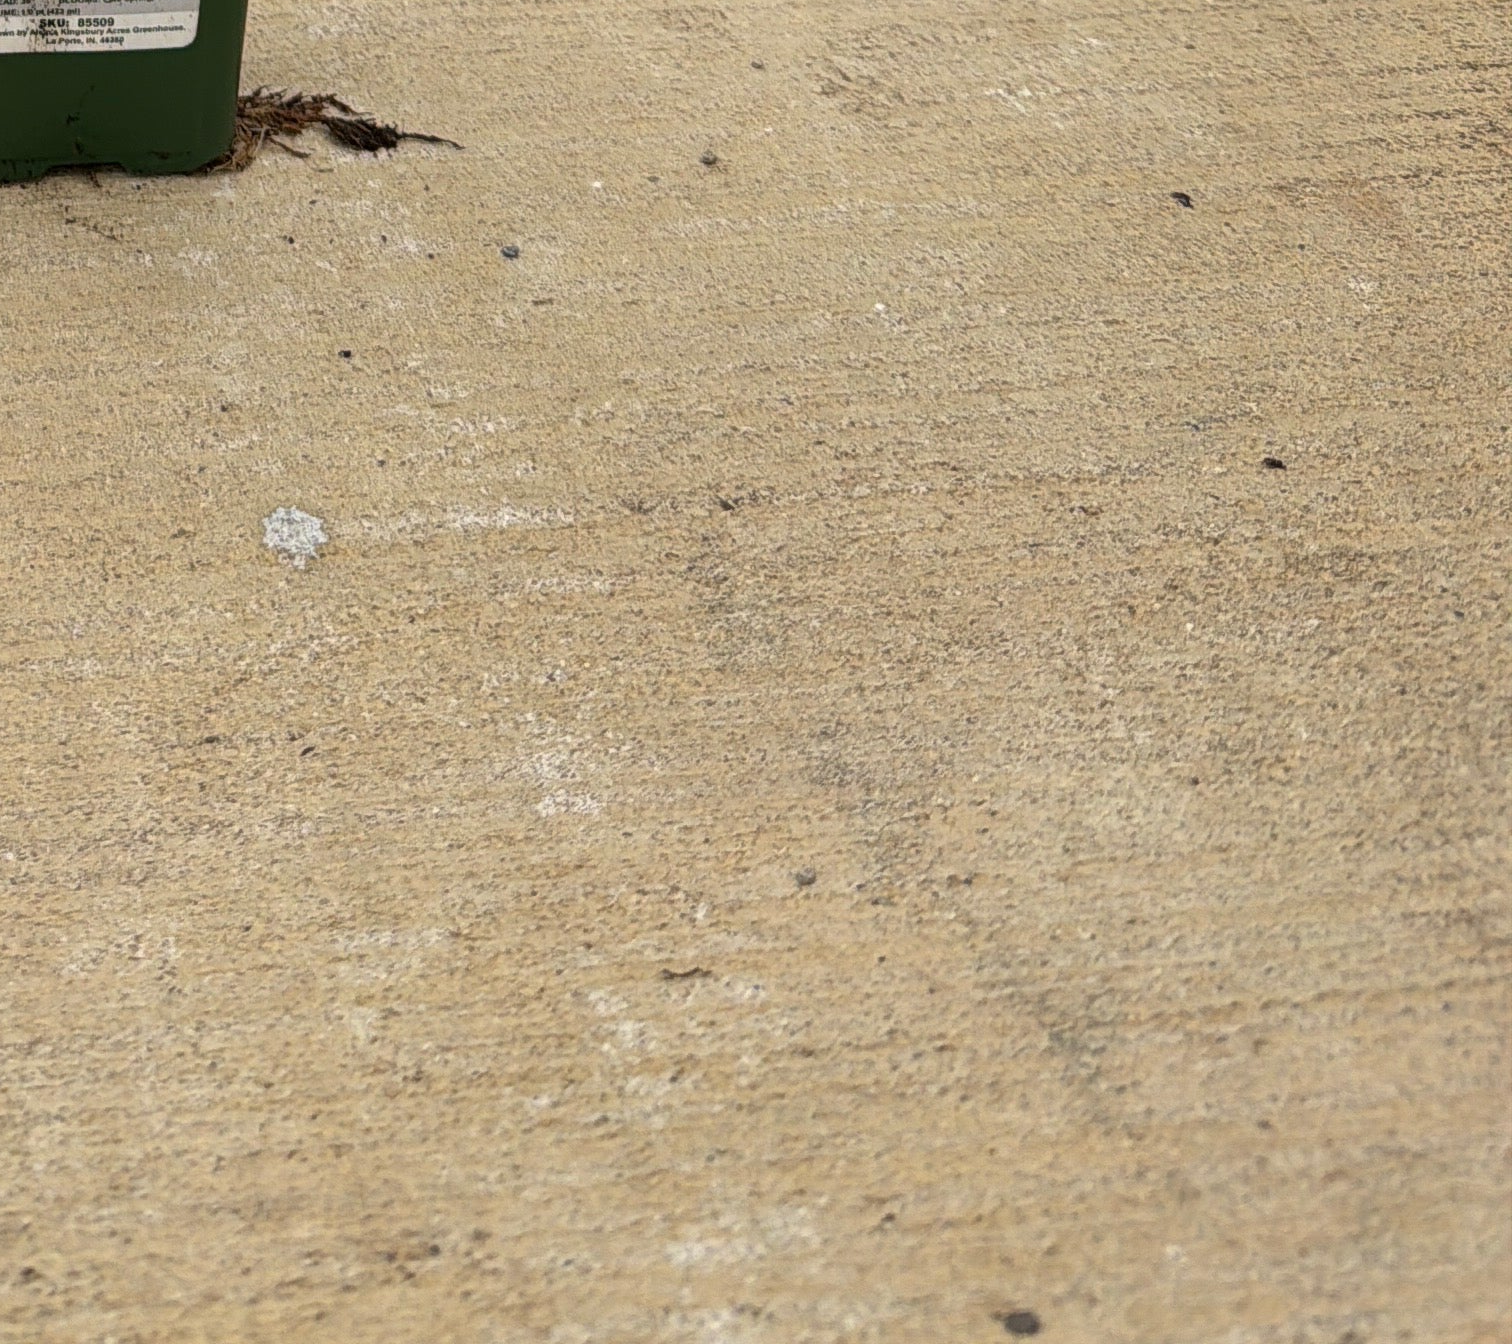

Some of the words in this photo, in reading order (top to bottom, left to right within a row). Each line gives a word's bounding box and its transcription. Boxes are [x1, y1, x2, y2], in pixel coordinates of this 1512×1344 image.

[39, 18, 70, 28] SKU:
[78, 17, 114, 27] 85509
[61, 26, 105, 36] Kingsbury
